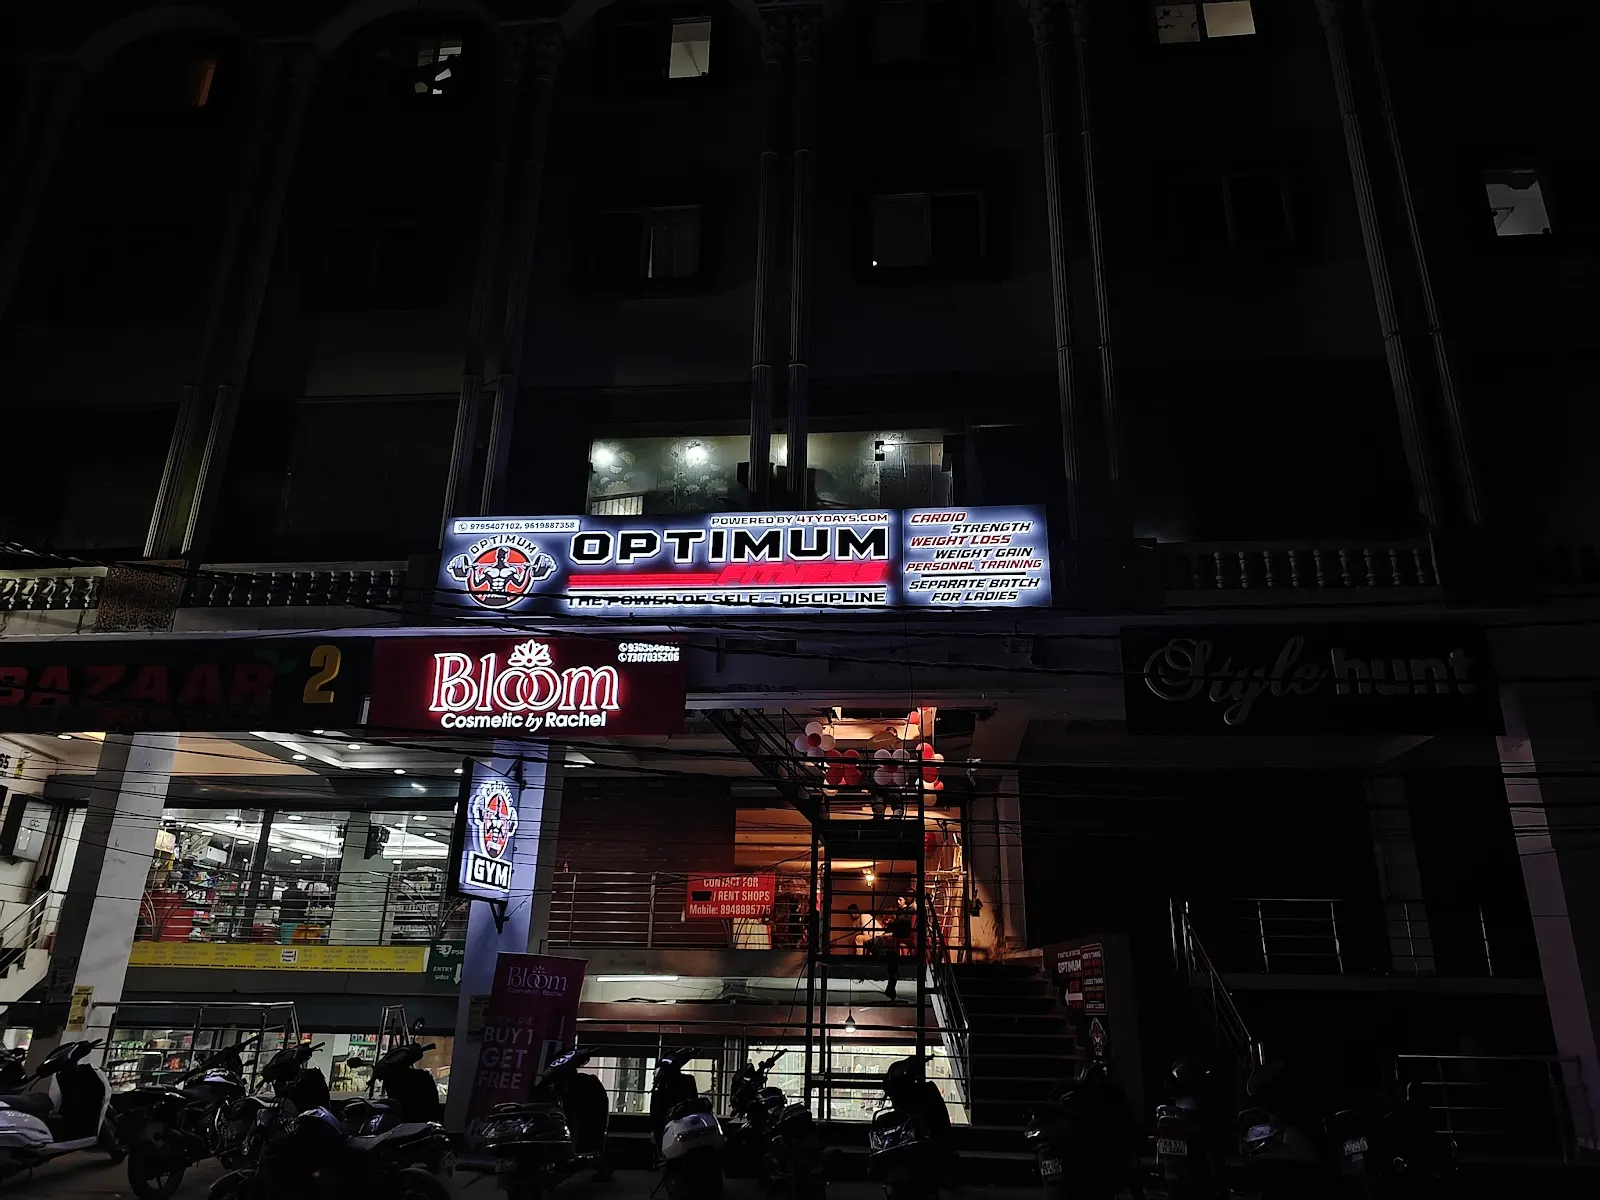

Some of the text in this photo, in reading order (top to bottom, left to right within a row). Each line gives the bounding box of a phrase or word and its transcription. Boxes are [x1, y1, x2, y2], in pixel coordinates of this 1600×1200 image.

[711, 513, 888, 526] POWERED BY 4TYDAYS.COM
[910, 512, 967, 524] CARDIO
[950, 522, 1032, 534] STRENGTH
[470, 534, 538, 555] OPTIMUM
[570, 526, 889, 565] OPTIMUM
[910, 534, 1012, 547] WEIGHT LOSS
[935, 547, 1034, 560] WEIGHT GAIN
[905, 559, 1043, 572] PERSONAL TRAINING
[718, 563, 888, 586] FITNESS
[909, 577, 1041, 590] SEPARATE BATCH
[779, 592, 886, 605] DISCIPLINE
[931, 591, 1019, 602] FOR LADIES
[0, 644, 342, 707] BAZAAR 2
[428, 652, 620, 712] Bloom
[1143, 635, 1480, 726] Style hunt
[441, 711, 607, 732] Cosmetic by Rachel
[473, 856, 509, 887] GYM
[742, 876, 759, 888] FOR
[718, 890, 740, 901] RENT
[741, 890, 771, 901] SHOPS
[689, 904, 718, 915] Mobile:
[507, 966, 567, 992] Bloom
[484, 1025, 534, 1046] BUY 1
[481, 1047, 528, 1069] GET
[477, 1069, 522, 1090] FREE
